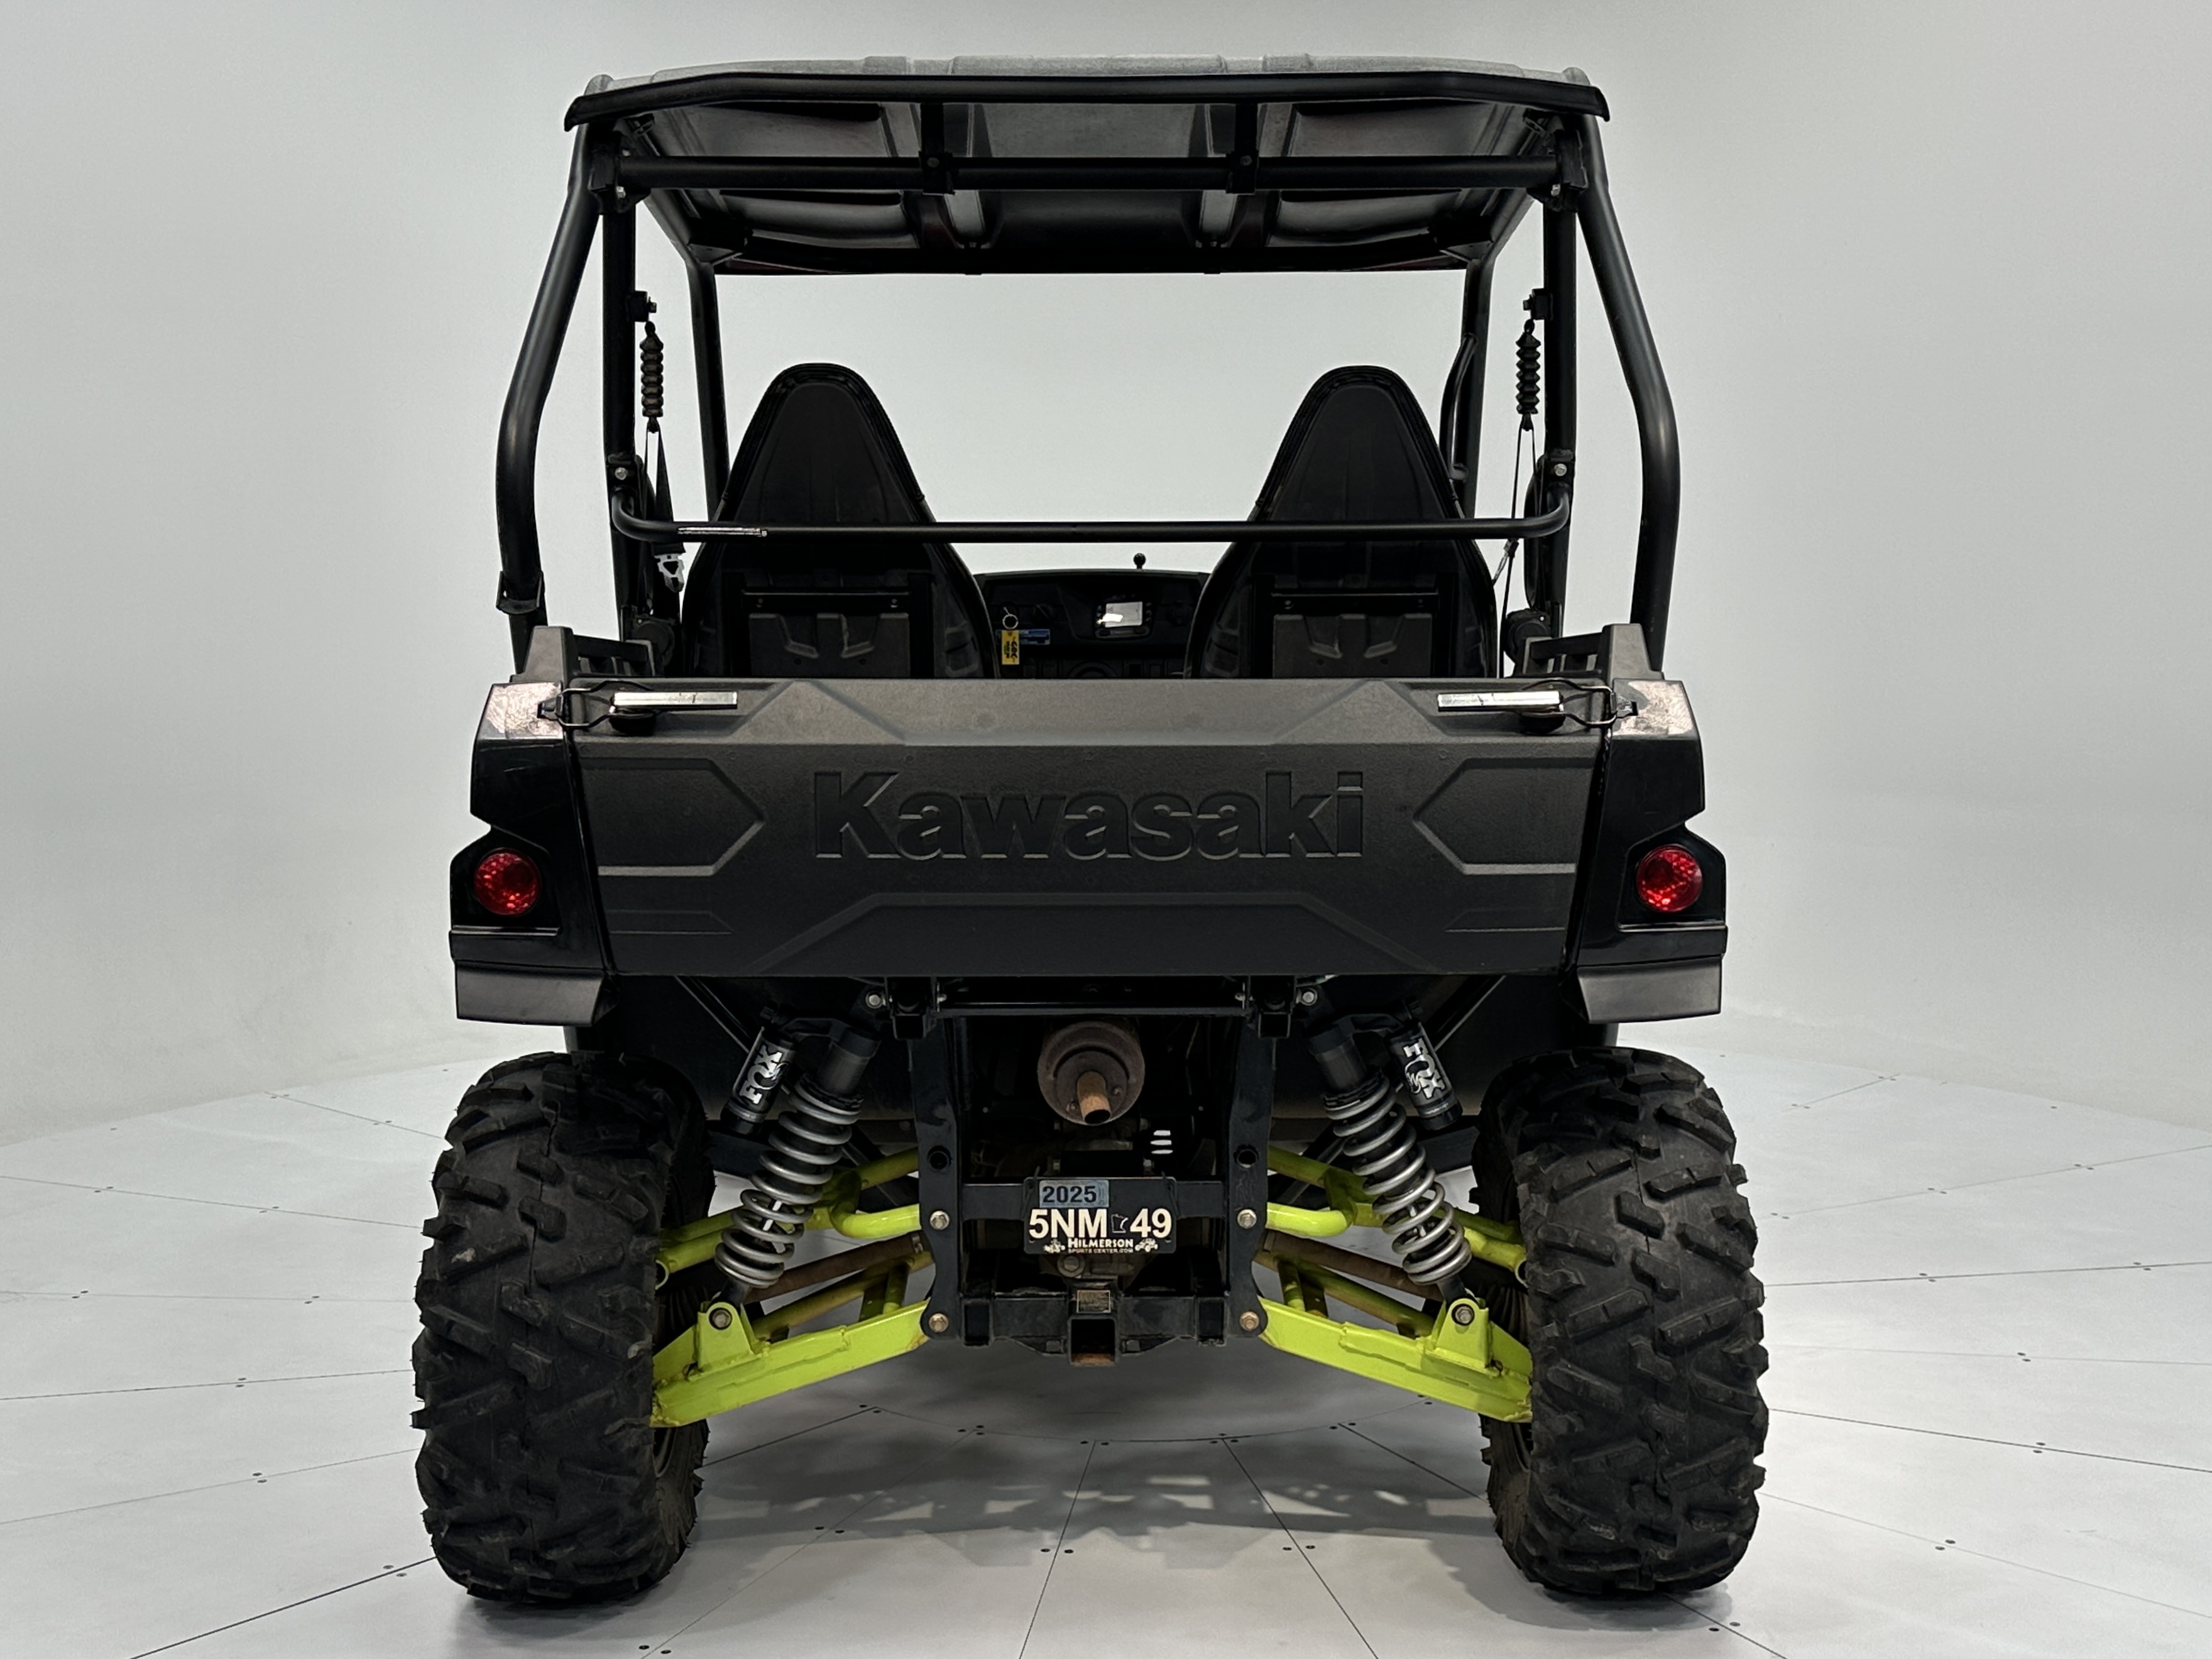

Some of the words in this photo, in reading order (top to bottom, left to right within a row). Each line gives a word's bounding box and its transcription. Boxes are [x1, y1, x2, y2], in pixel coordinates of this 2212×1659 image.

[814, 771, 1364, 861] Kawasaki
[738, 1044, 786, 1105] FOX
[1403, 1038, 1445, 1099] FOX
[1043, 1185, 1097, 1203] 2025
[1029, 1208, 1107, 1239] 5NM
[1129, 1208, 1172, 1239] 49
[1068, 1238, 1134, 1248] HILMERSON
